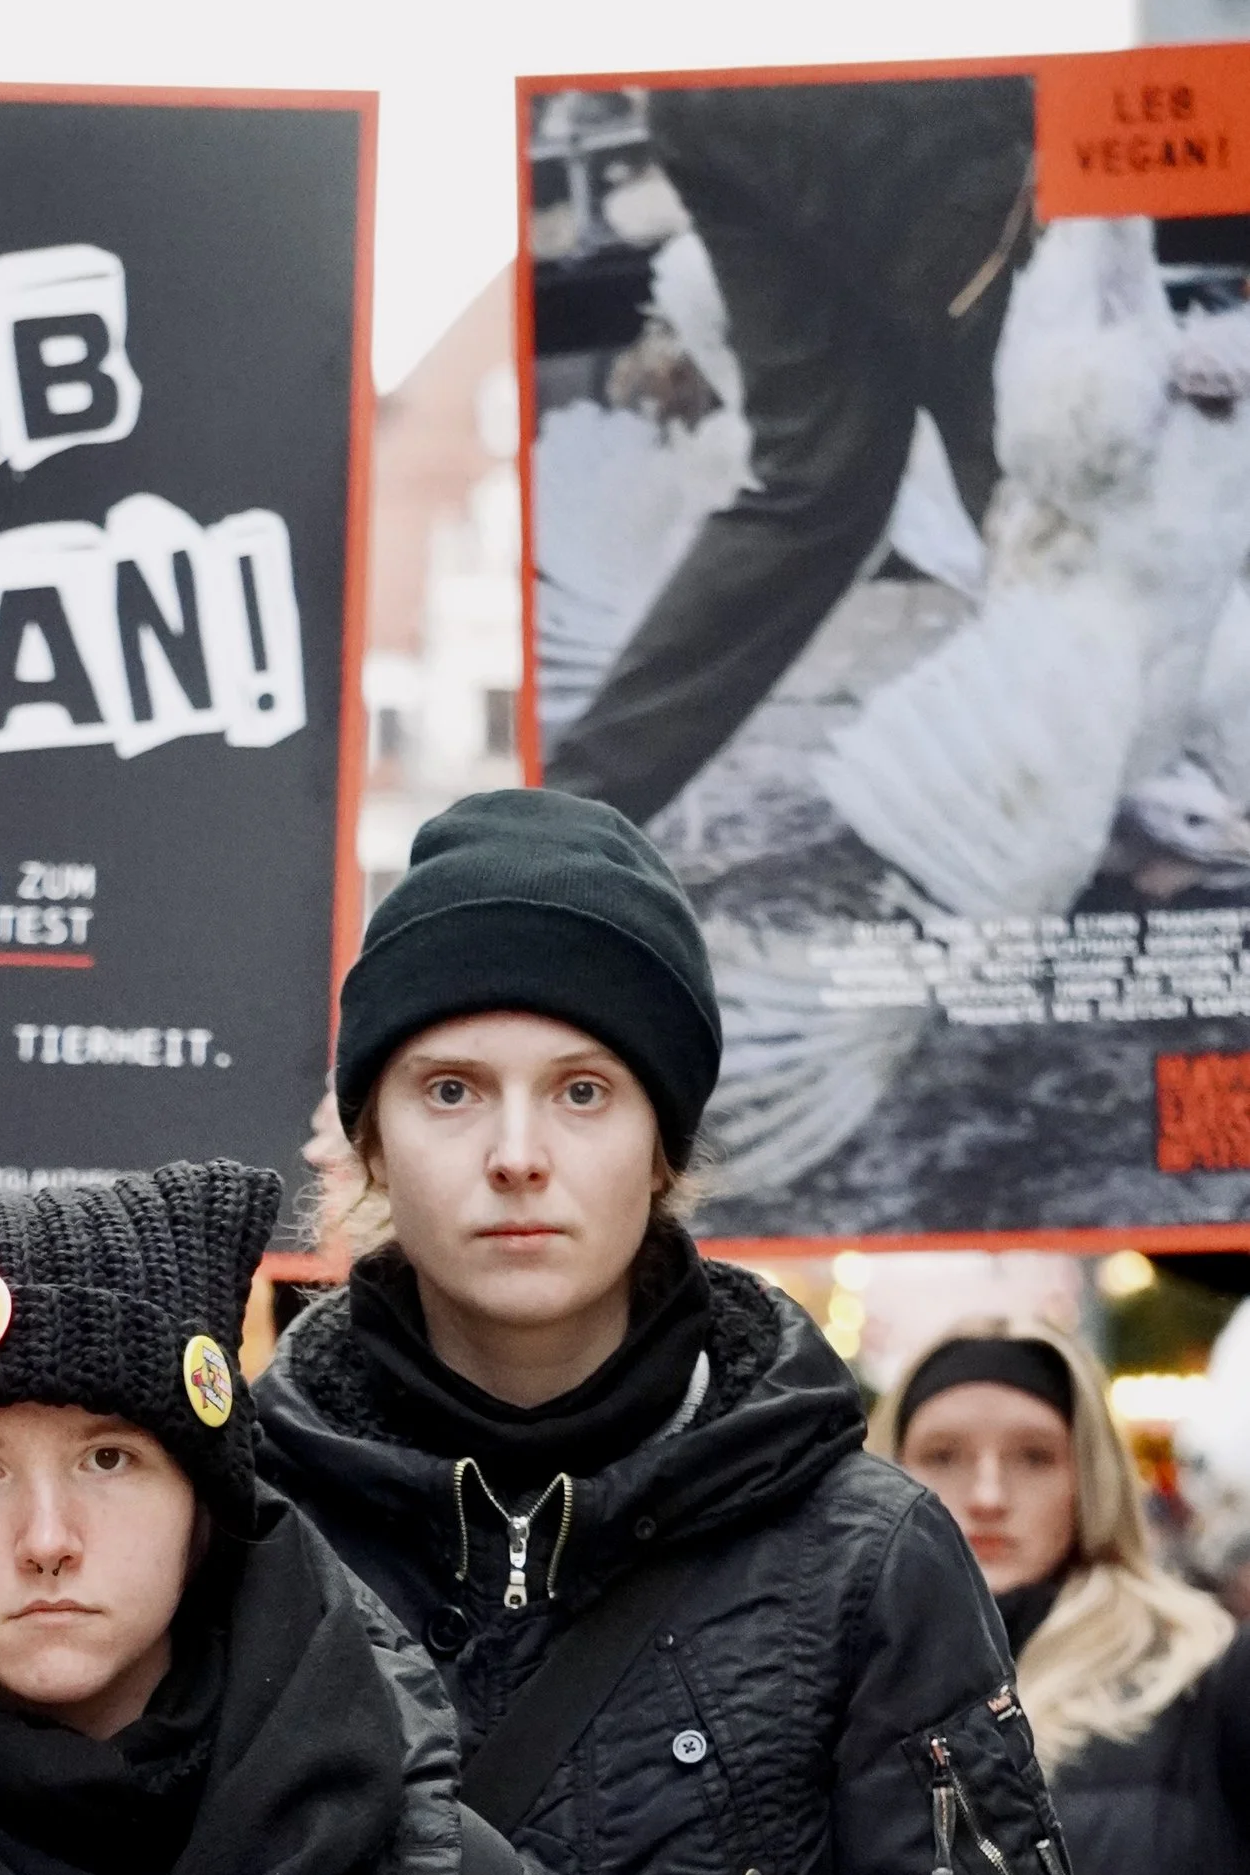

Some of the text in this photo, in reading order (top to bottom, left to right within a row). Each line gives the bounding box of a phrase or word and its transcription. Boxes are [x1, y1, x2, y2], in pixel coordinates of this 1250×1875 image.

[1113, 83, 1194, 124] LEB
[1075, 132, 1230, 176] VEGAN!
[17, 860, 97, 900] ZUM
[14, 1022, 233, 1069] TIERHEIT.
